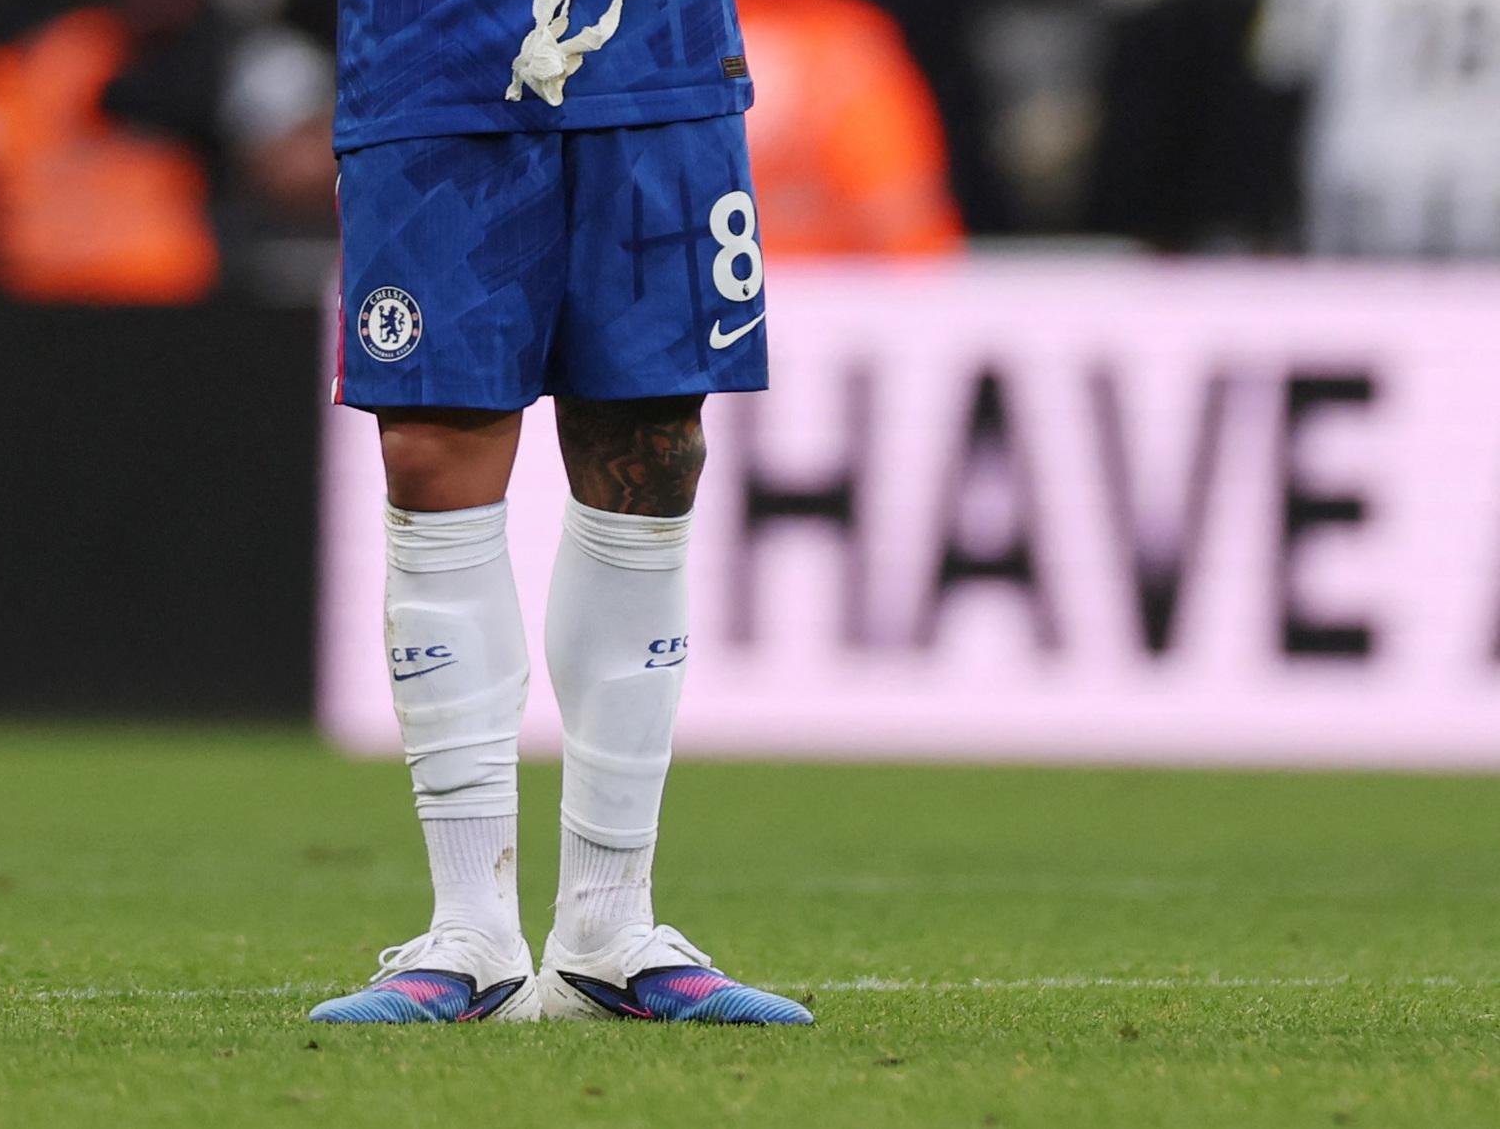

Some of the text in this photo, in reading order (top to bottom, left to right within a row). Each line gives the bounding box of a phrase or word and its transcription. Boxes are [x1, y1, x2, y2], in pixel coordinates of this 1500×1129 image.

[709, 190, 764, 302] 8
[369, 289, 410, 306] CHELSEA
[726, 359, 1375, 658] HAVE
[391, 645, 453, 663] CFC
